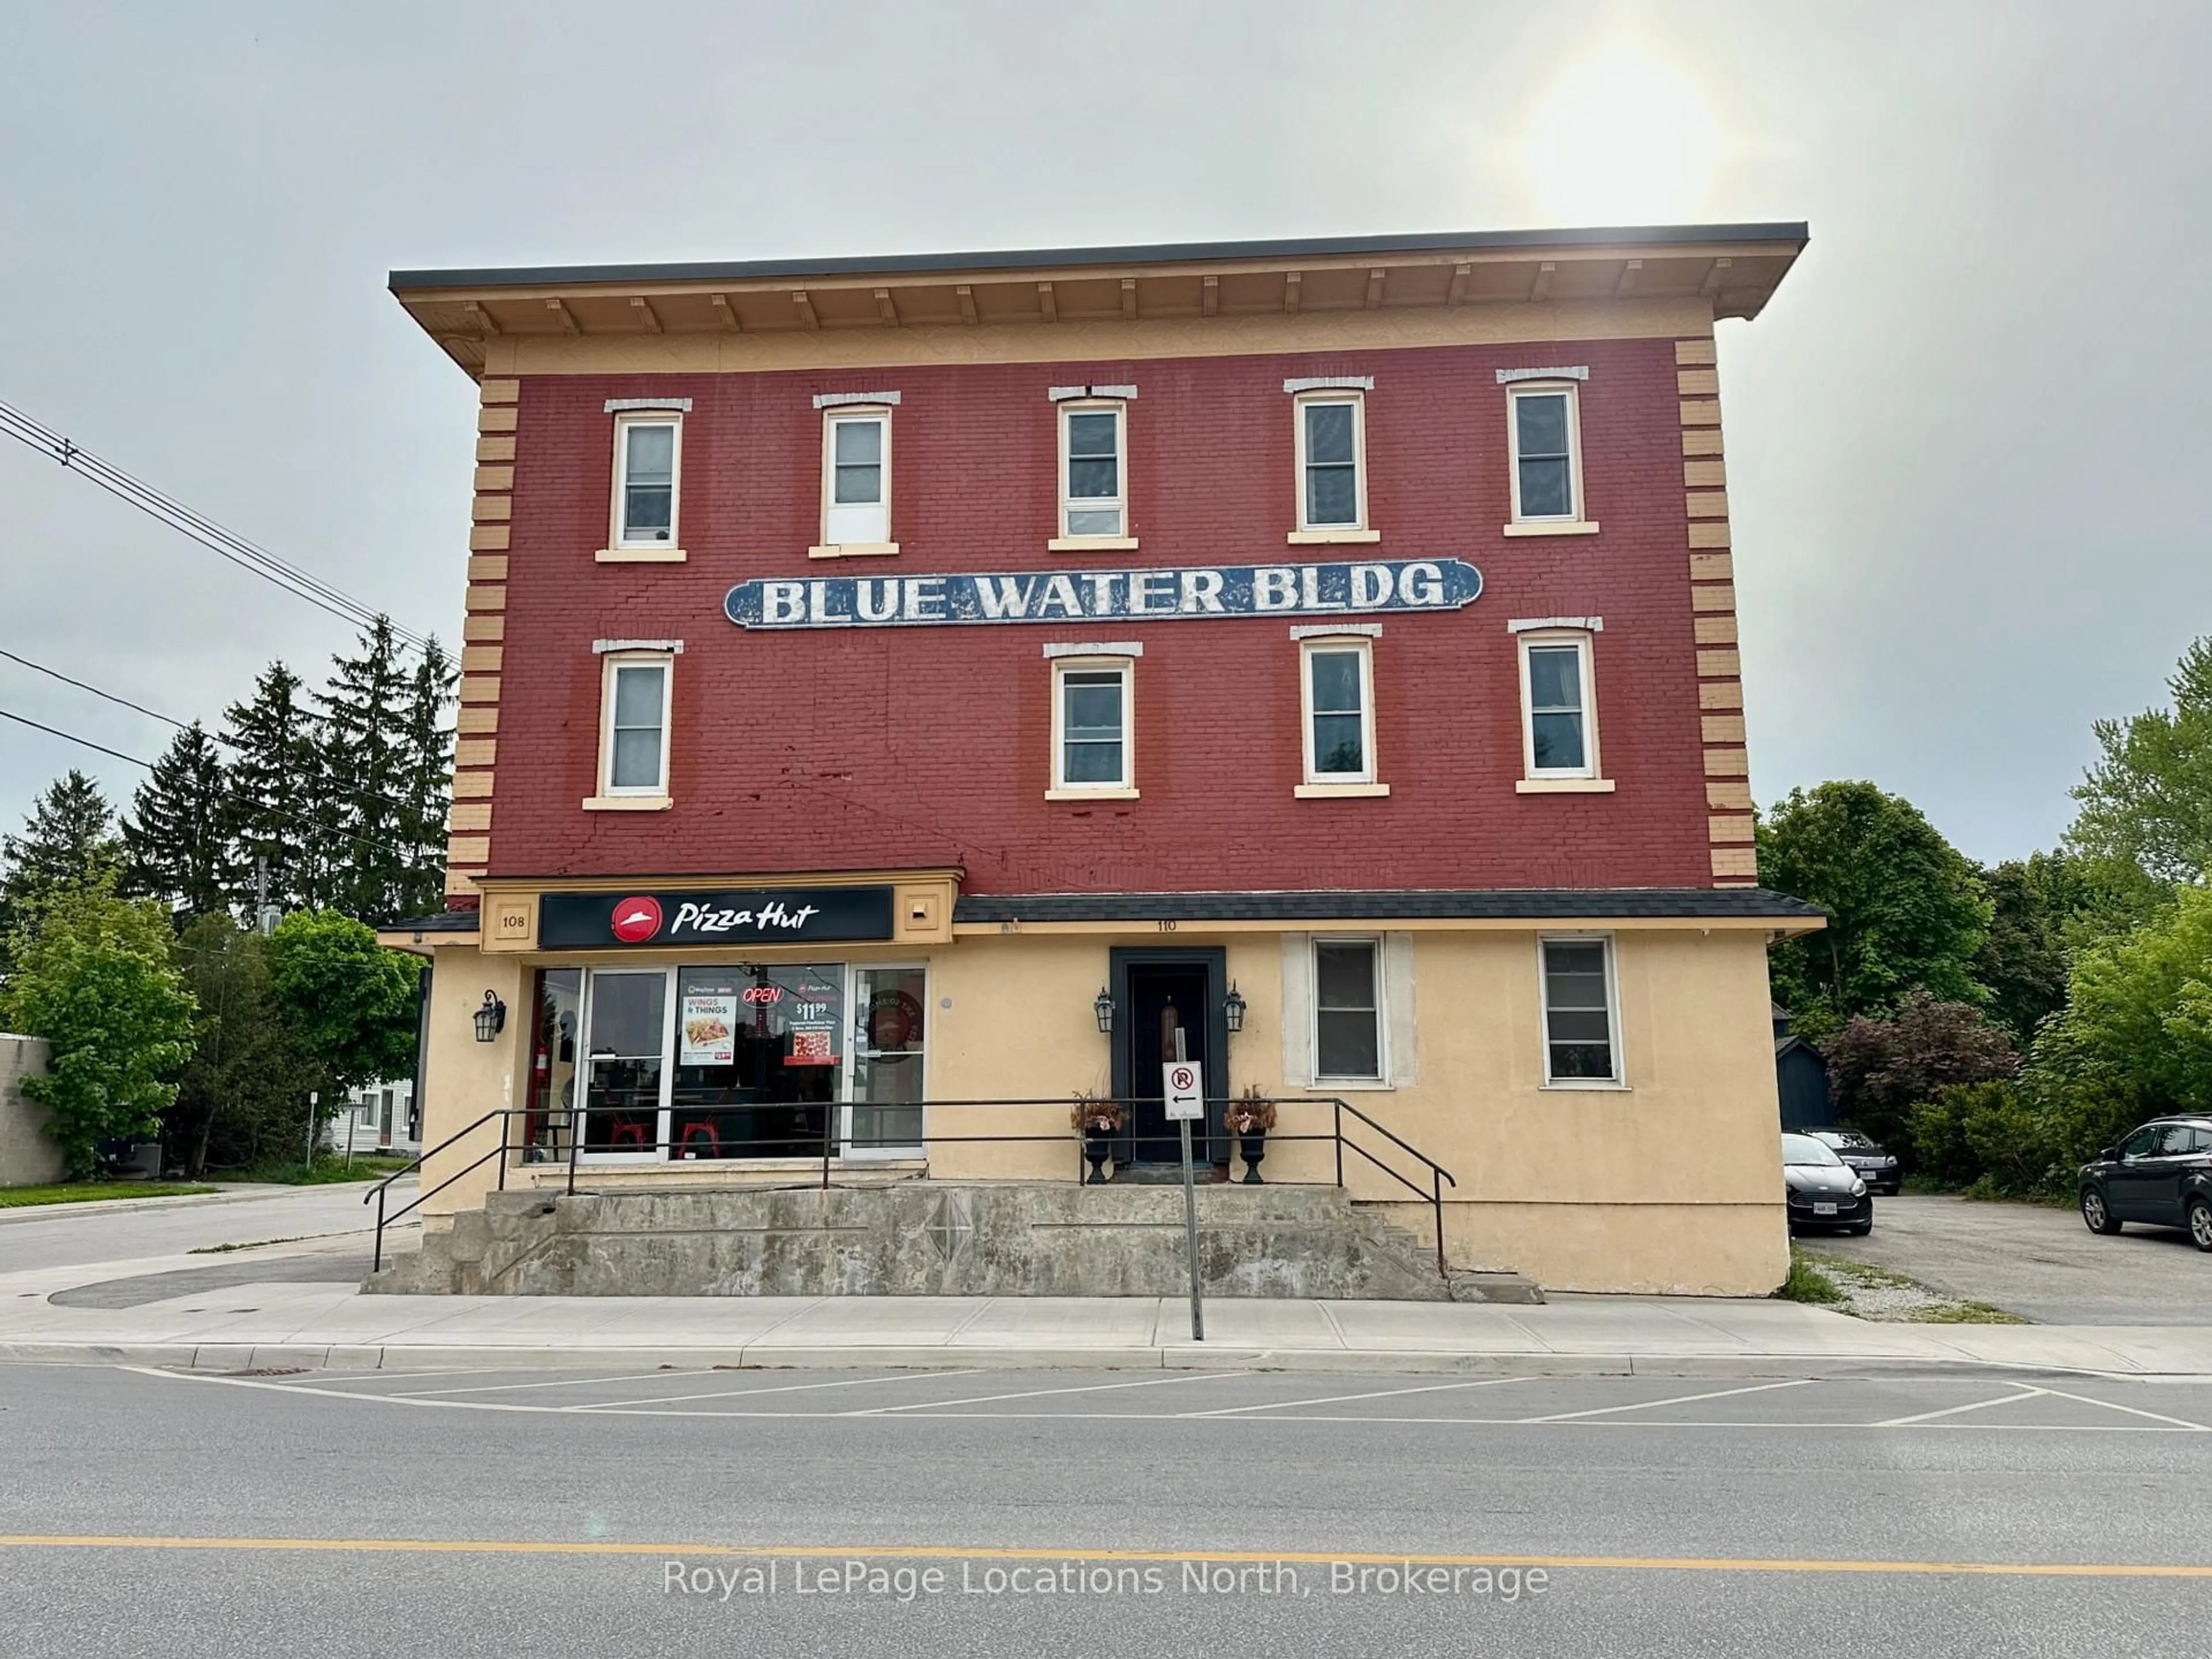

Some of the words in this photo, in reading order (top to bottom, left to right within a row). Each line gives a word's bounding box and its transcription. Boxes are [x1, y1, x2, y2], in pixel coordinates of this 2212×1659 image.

[762, 578, 946, 624] BLUE
[974, 569, 1225, 619] WATER
[1252, 563, 1444, 611] BLDG
[503, 916, 524, 929] 108
[671, 902, 753, 934] Pizza
[756, 901, 820, 929] Hut
[1158, 921, 1177, 931] 110
[743, 988, 781, 1003] OPEN
